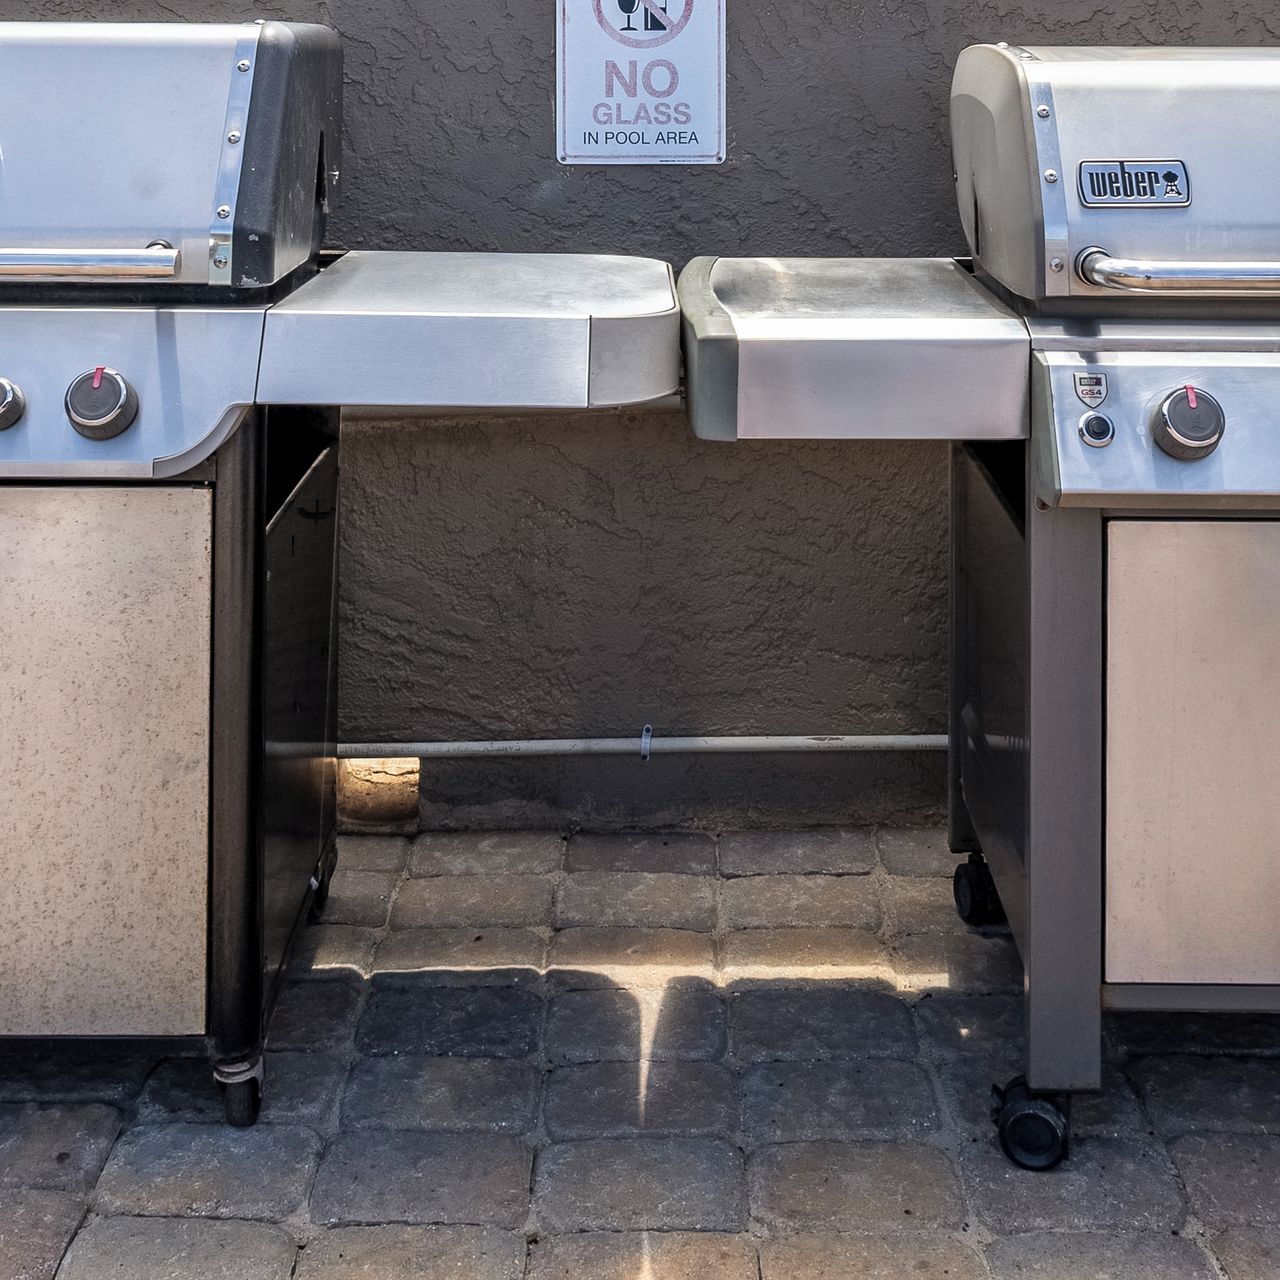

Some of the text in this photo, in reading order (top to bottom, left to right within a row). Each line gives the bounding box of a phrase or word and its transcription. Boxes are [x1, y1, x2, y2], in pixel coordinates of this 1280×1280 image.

[605, 59, 679, 98] NO
[592, 102, 692, 125] GLASS
[583, 131, 699, 145] IN POOL AREA
[1087, 161, 1161, 198] weber
